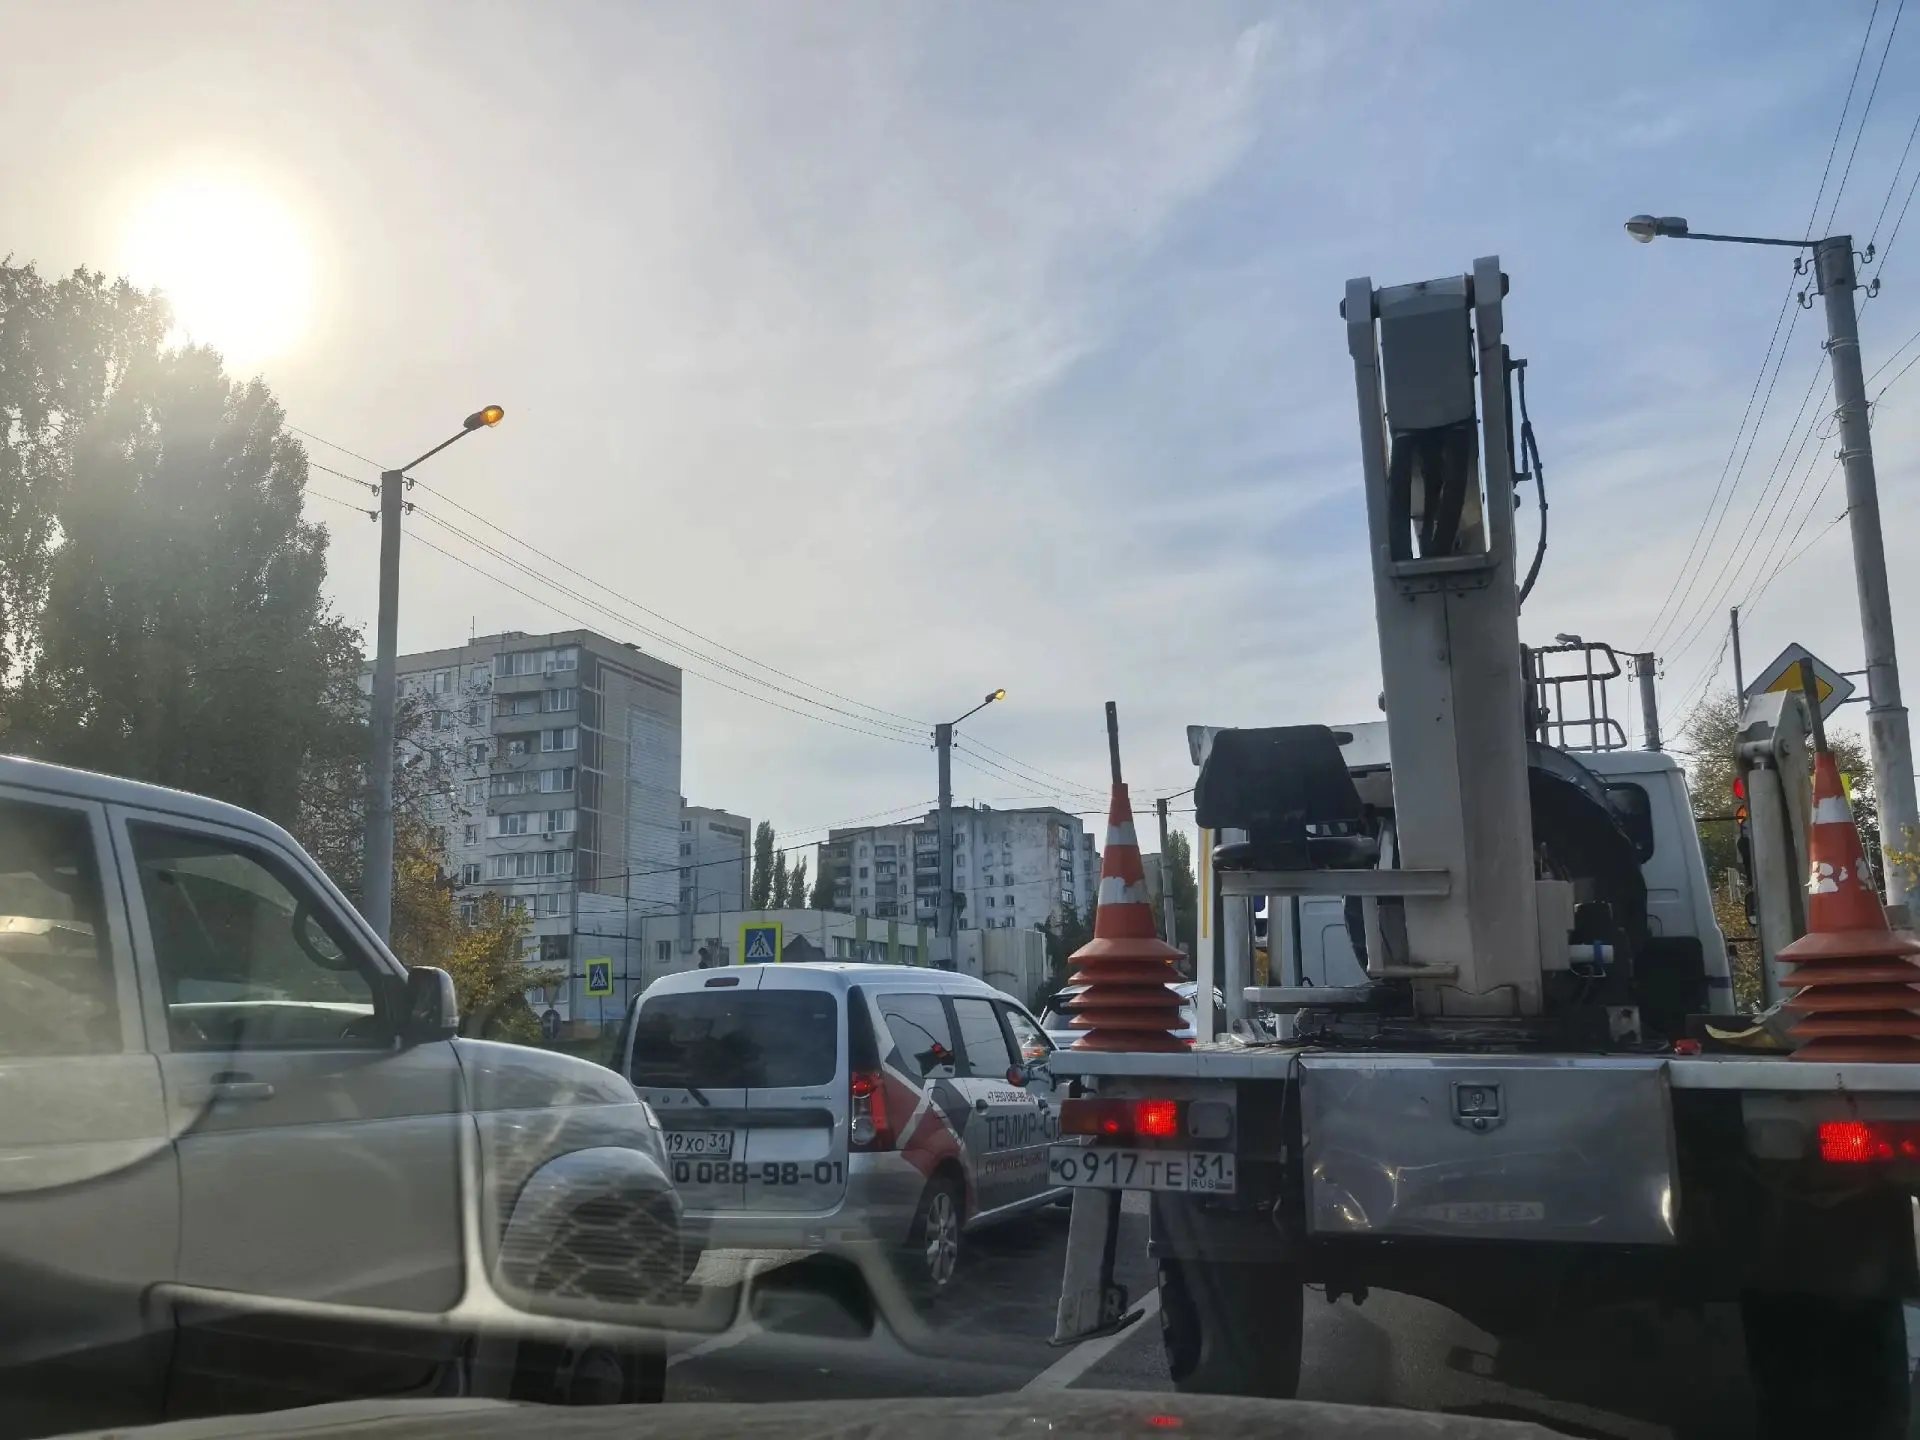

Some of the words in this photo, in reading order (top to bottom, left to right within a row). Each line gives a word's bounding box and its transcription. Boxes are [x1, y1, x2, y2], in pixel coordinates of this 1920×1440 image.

[985, 1111, 1061, 1149] ТЕМИР-СТ
[709, 1133, 726, 1148] 31
[1193, 1154, 1224, 1179] 31
[1191, 1178, 1215, 1189] RUS
